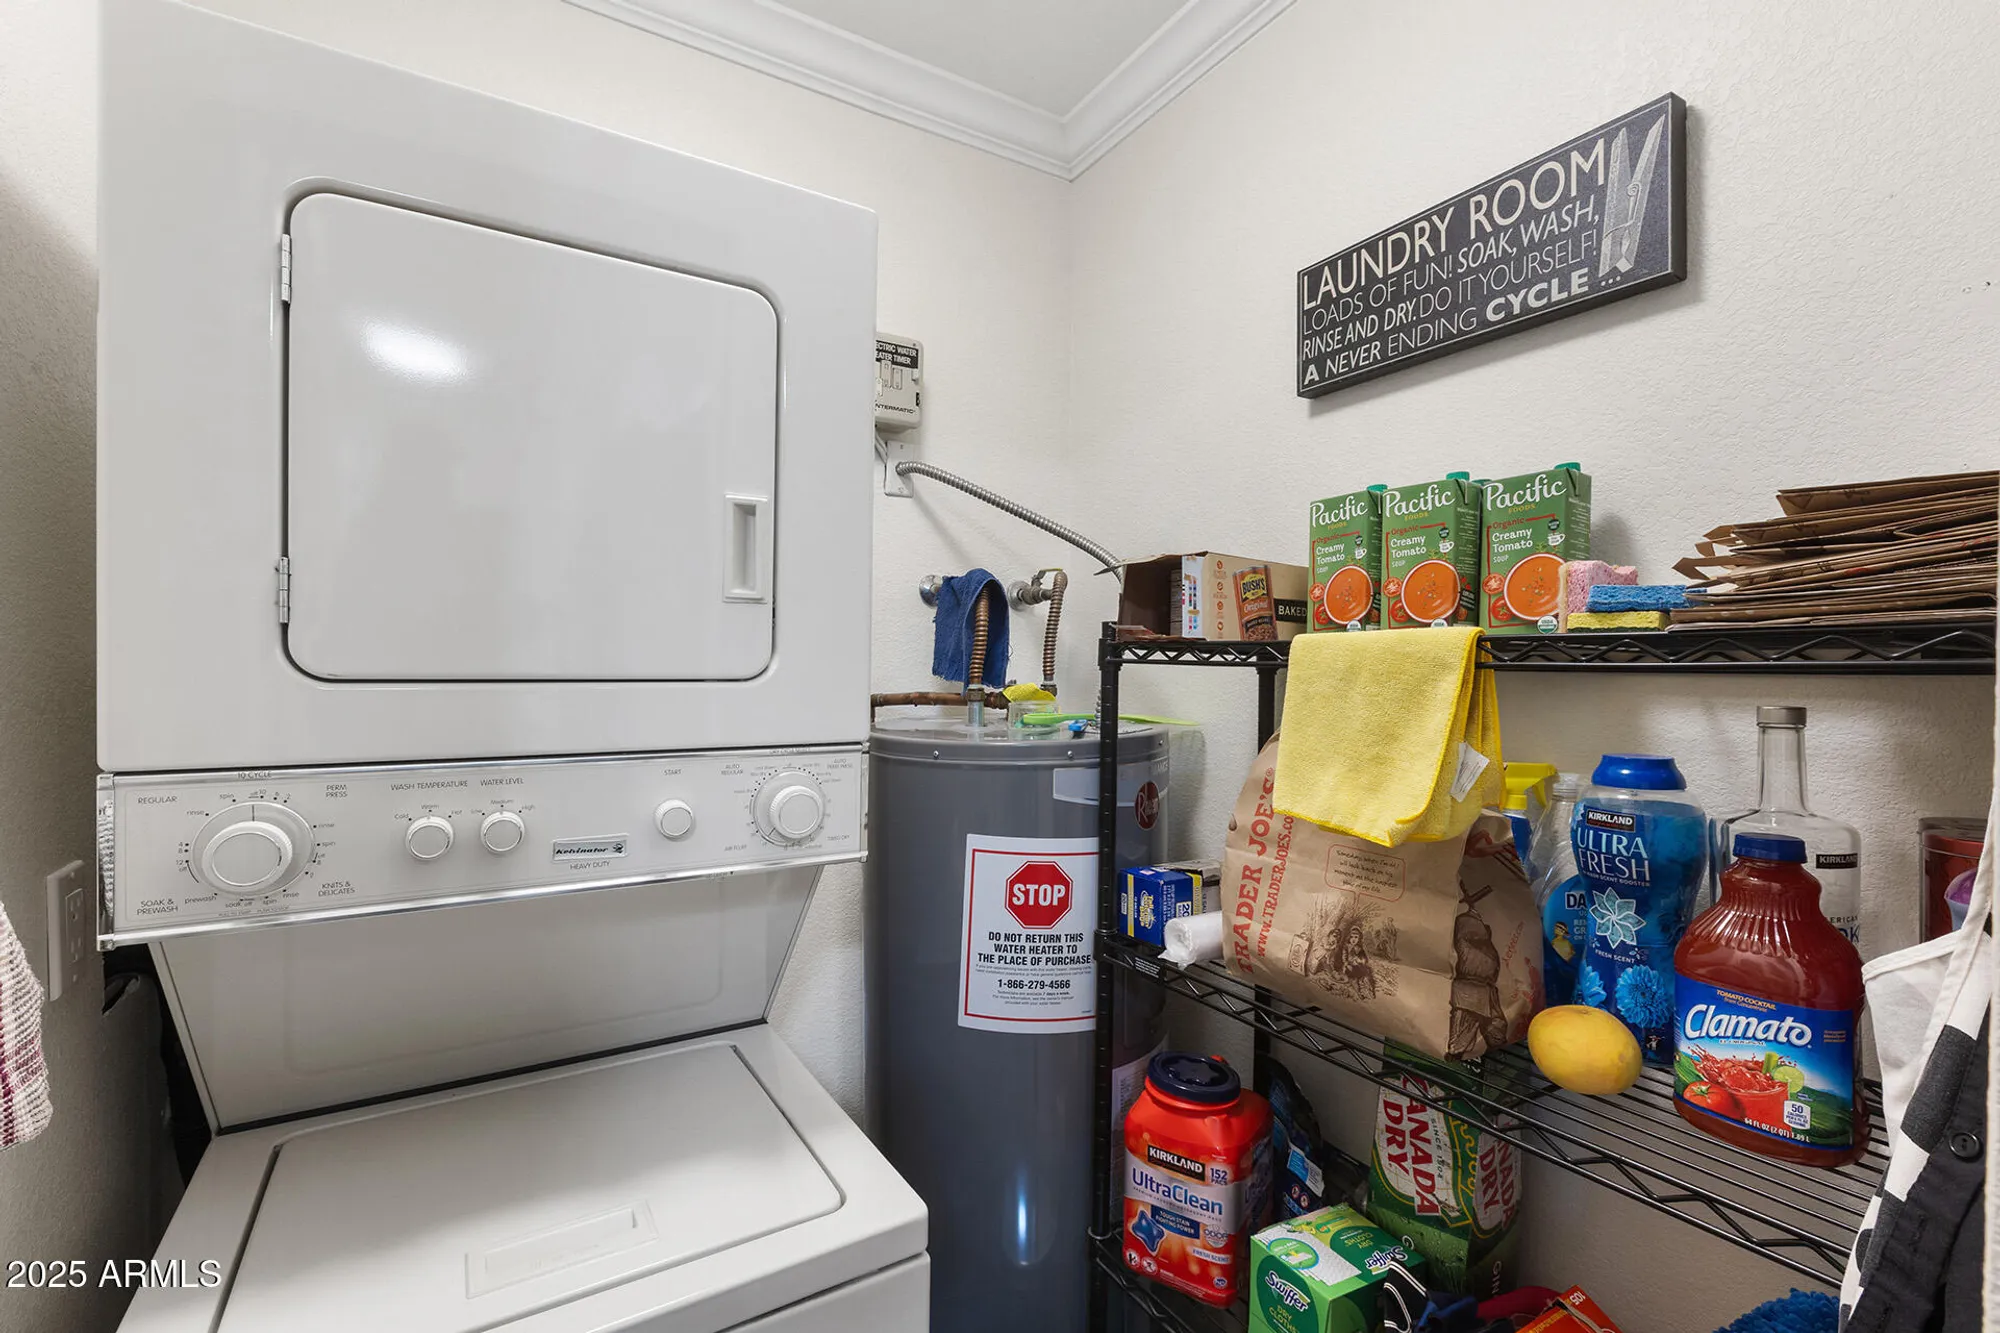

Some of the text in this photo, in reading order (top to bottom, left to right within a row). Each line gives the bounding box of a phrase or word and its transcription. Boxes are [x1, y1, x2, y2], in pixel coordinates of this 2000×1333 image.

[1303, 138, 1605, 310] LAUNDRY ROOM
[1303, 199, 1600, 335] LOADS OF FUN! SOAK, WASH,
[1303, 229, 1598, 361] RINSE AND DRY. DO IT YOURSELF!
[1303, 266, 1589, 385] A NEVER ENDING CYCLE
[1482, 474, 1567, 511] Pacific
[1383, 485, 1455, 518] Pacific
[1310, 495, 1368, 528] Pacific
[1391, 523, 1419, 536] Organic
[1492, 517, 1525, 530] Organic
[1390, 534, 1426, 548] Creamy
[1492, 527, 1533, 544] Creamy
[1316, 542, 1345, 556] Creamy
[1391, 545, 1427, 559] Tomato
[1492, 539, 1533, 553] Tomato
[1316, 553, 1345, 566] Tomato
[1278, 604, 1307, 616] BAKED
[417, 780, 468, 789] TEMPERATURE
[505, 777, 525, 785] LEVEL
[138, 796, 178, 804] REGULAR
[326, 790, 348, 798] PRESS
[1588, 811, 1633, 826] KIRKLAND
[1576, 827, 1648, 860] ULTRA
[570, 860, 610, 870] HEAVY DUTY
[1578, 848, 1650, 881] FRESH
[1233, 773, 1274, 974] TRADER JOE'S
[1600, 874, 1650, 887] SCENT BOOSTER
[318, 887, 356, 897] DELICATES
[1012, 883, 1066, 906] STOP
[141, 900, 167, 908] SOAK
[185, 895, 217, 904] prewash
[137, 906, 178, 915] PREWASH
[988, 932, 1084, 944] DO NOT RETURN THIS
[994, 943, 1078, 955] WATER HEATER TO
[978, 953, 1091, 966] THE PLACE OF PURCHASE
[1595, 949, 1636, 964] FRESH SCENT
[998, 979, 1071, 990] 1-866-279-4566
[1717, 989, 1777, 1010] TOMATO COCKTAIL
[1685, 1003, 1812, 1047] Clamato
[1791, 1103, 1804, 1114] 50
[1753, 1120, 1761, 1128] FL
[1762, 1123, 1770, 1131] OZ
[1384, 1099, 1410, 1176] DRY
[1431, 1118, 1442, 1151] SINCE
[1403, 1074, 1440, 1214] CANADA
[1149, 1146, 1204, 1173] KIRKLAND
[1210, 1167, 1227, 1180] 152
[1480, 1145, 1500, 1212] DRY
[1132, 1168, 1223, 1216] UltraClean
[1366, 1246, 1408, 1269] Swiffer
[1265, 1271, 1309, 1311] Swiffer
[1277, 1305, 1292, 1320] DRY
